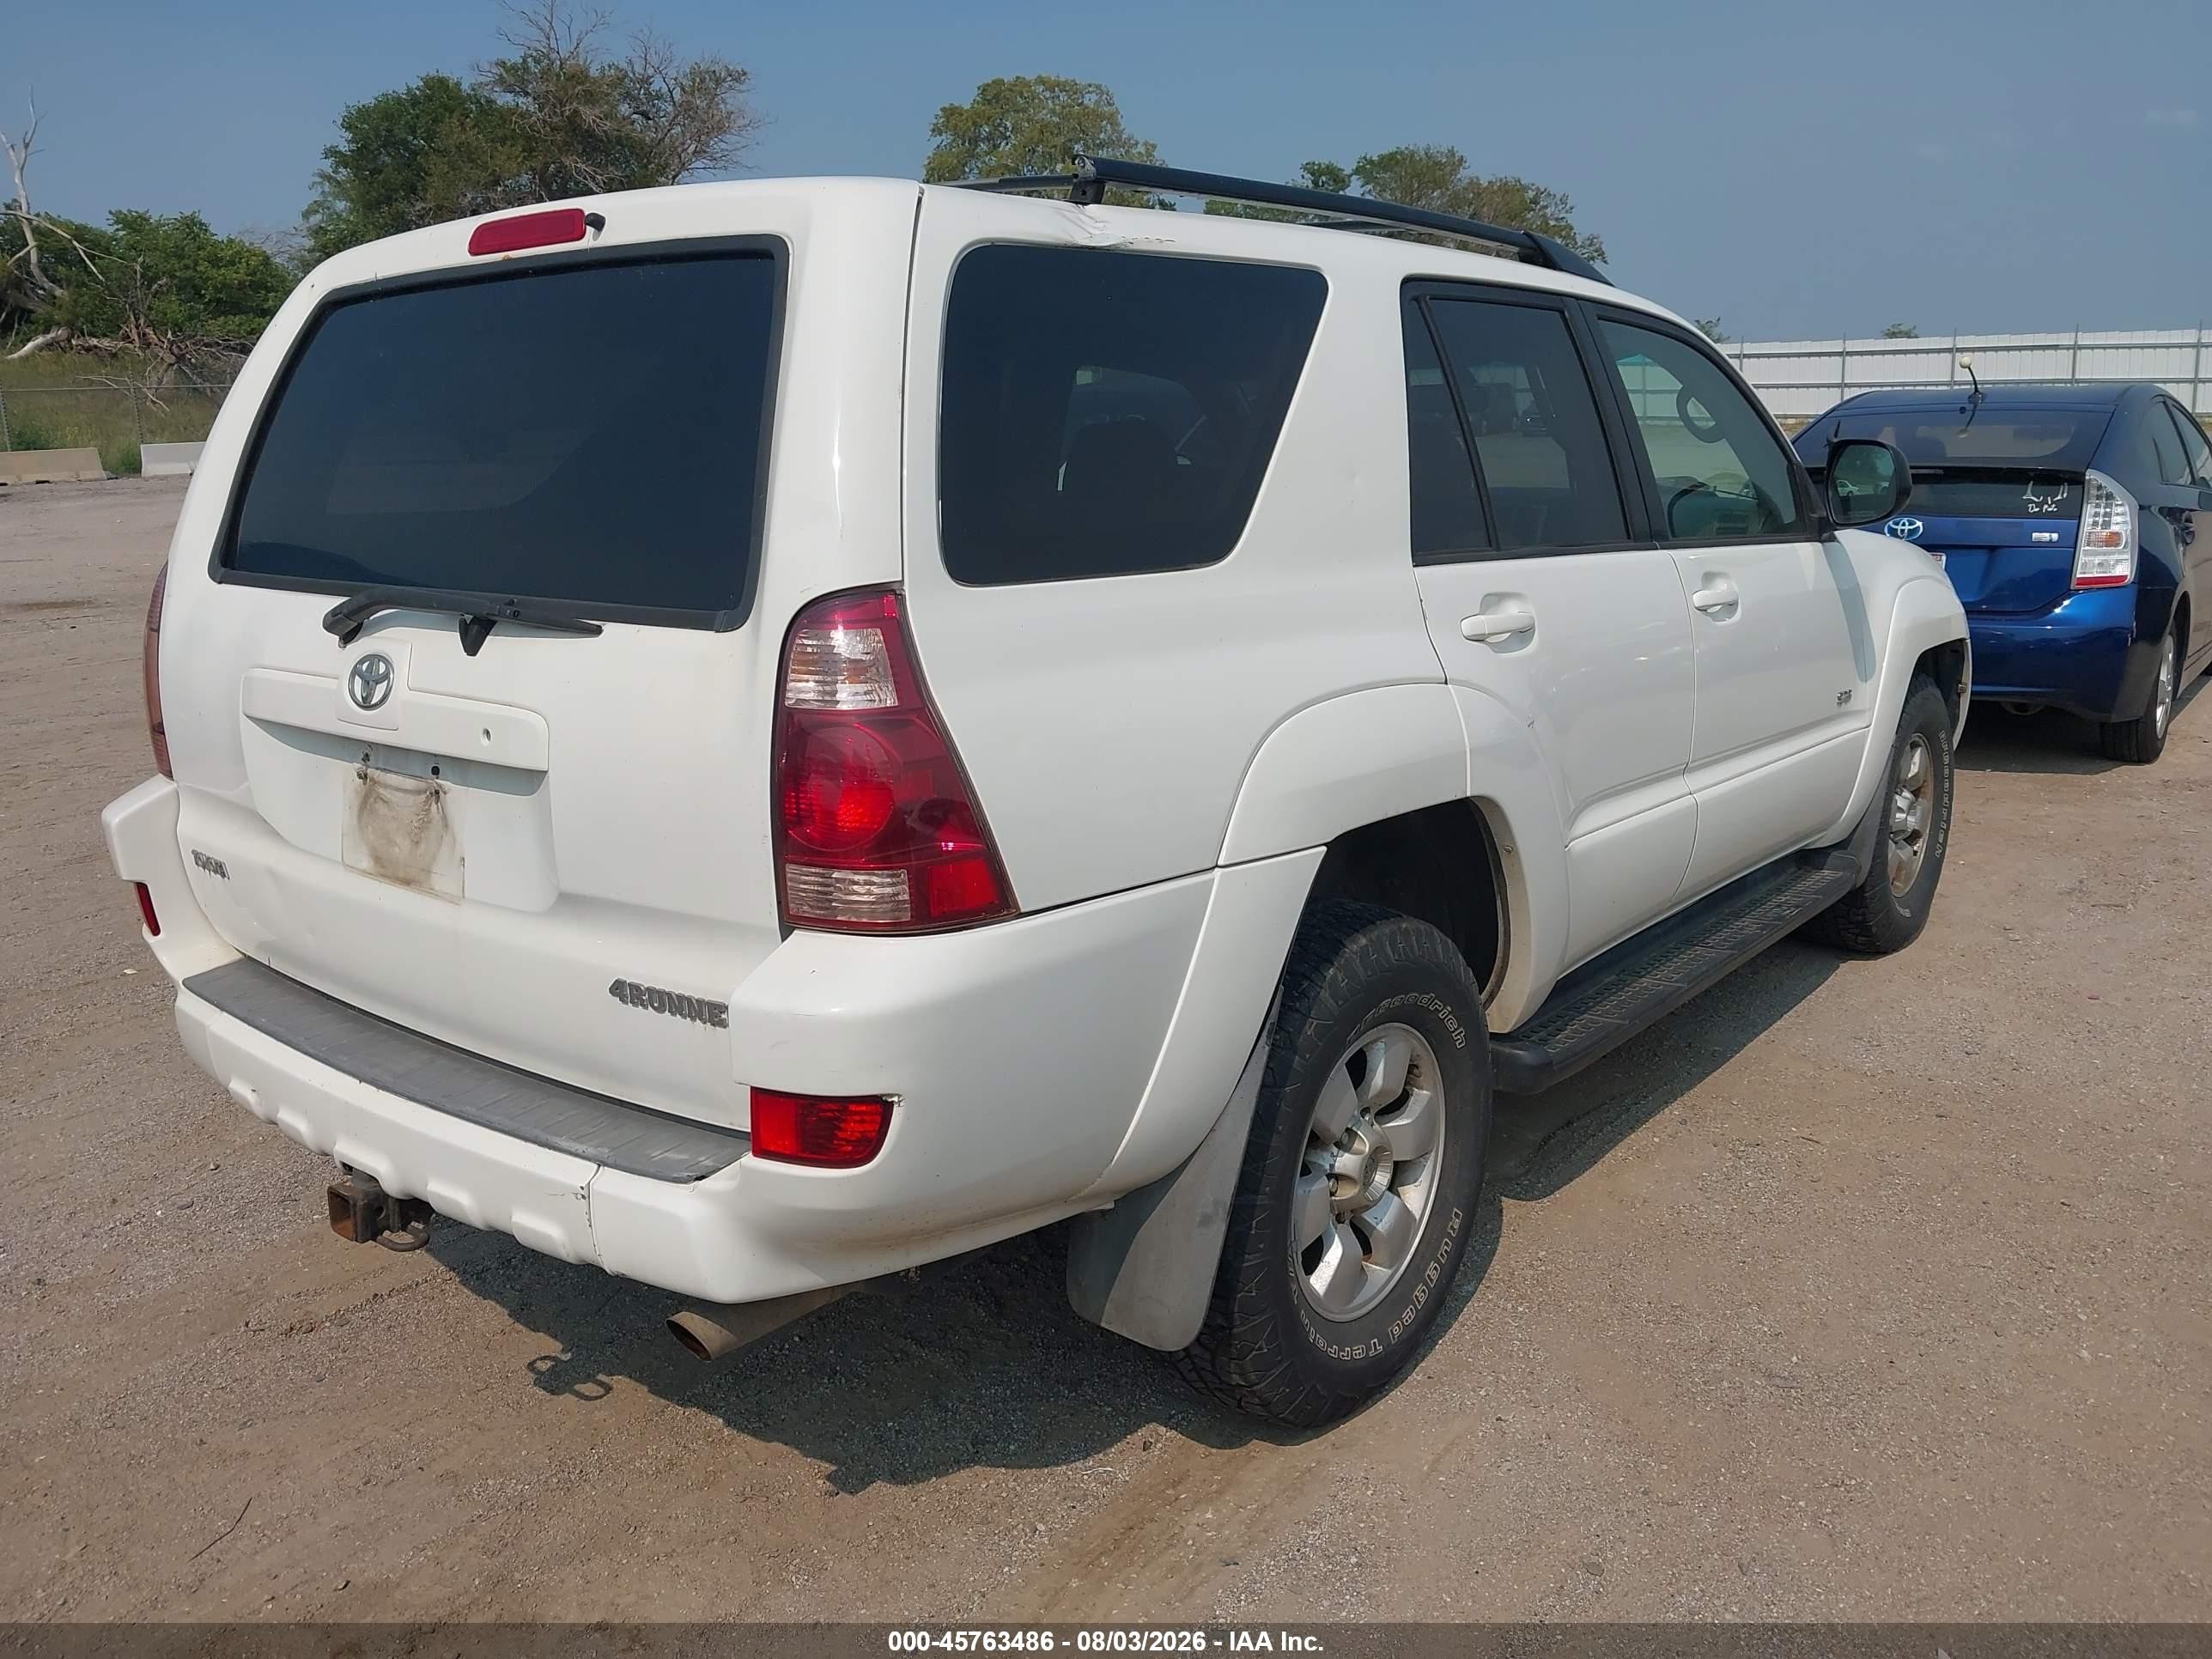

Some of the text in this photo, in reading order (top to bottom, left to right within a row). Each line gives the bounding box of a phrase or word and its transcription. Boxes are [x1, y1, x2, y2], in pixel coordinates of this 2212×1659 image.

[608, 977, 729, 1030] 4RUNNE
[1388, 1207, 1463, 1345] Rugged
[1300, 1310, 1383, 1361] Terrain
